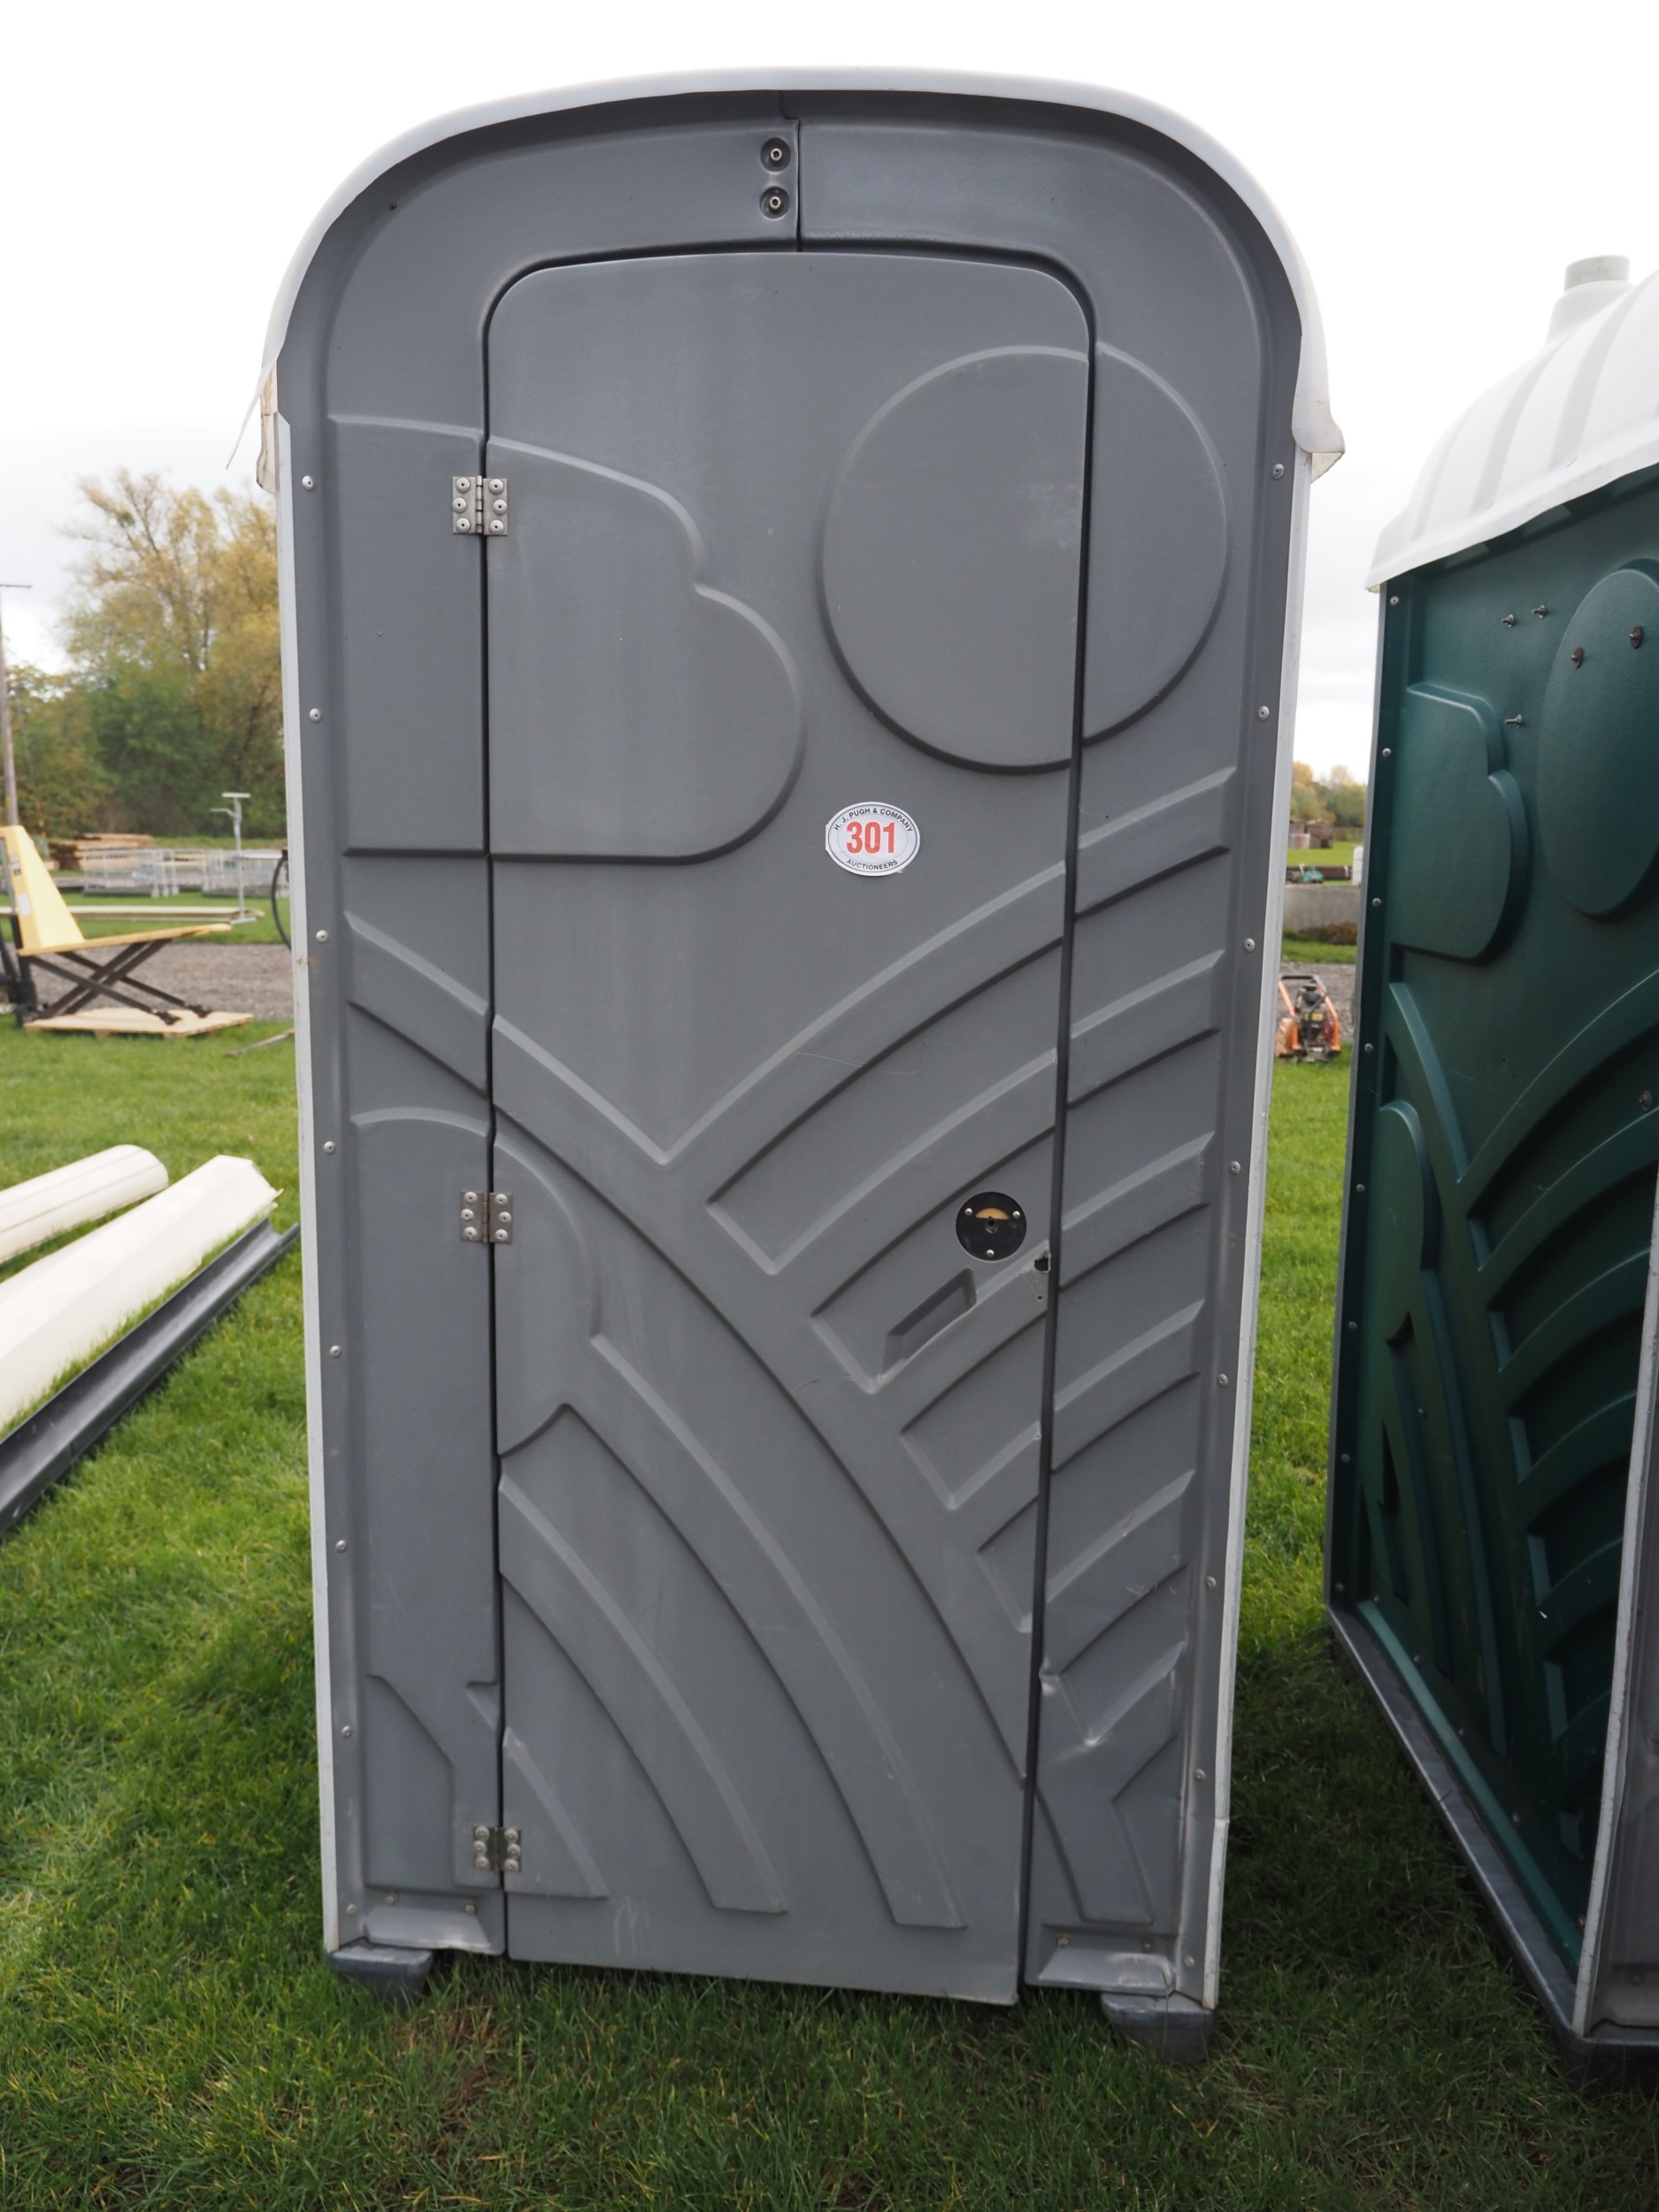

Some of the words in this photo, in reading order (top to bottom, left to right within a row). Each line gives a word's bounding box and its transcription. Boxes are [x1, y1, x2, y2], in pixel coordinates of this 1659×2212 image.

[849, 808, 871, 818] PUGH
[879, 808, 914, 833] COMPANY
[846, 821, 895, 854] 301
[847, 858, 898, 871] AUCTIONEERS
